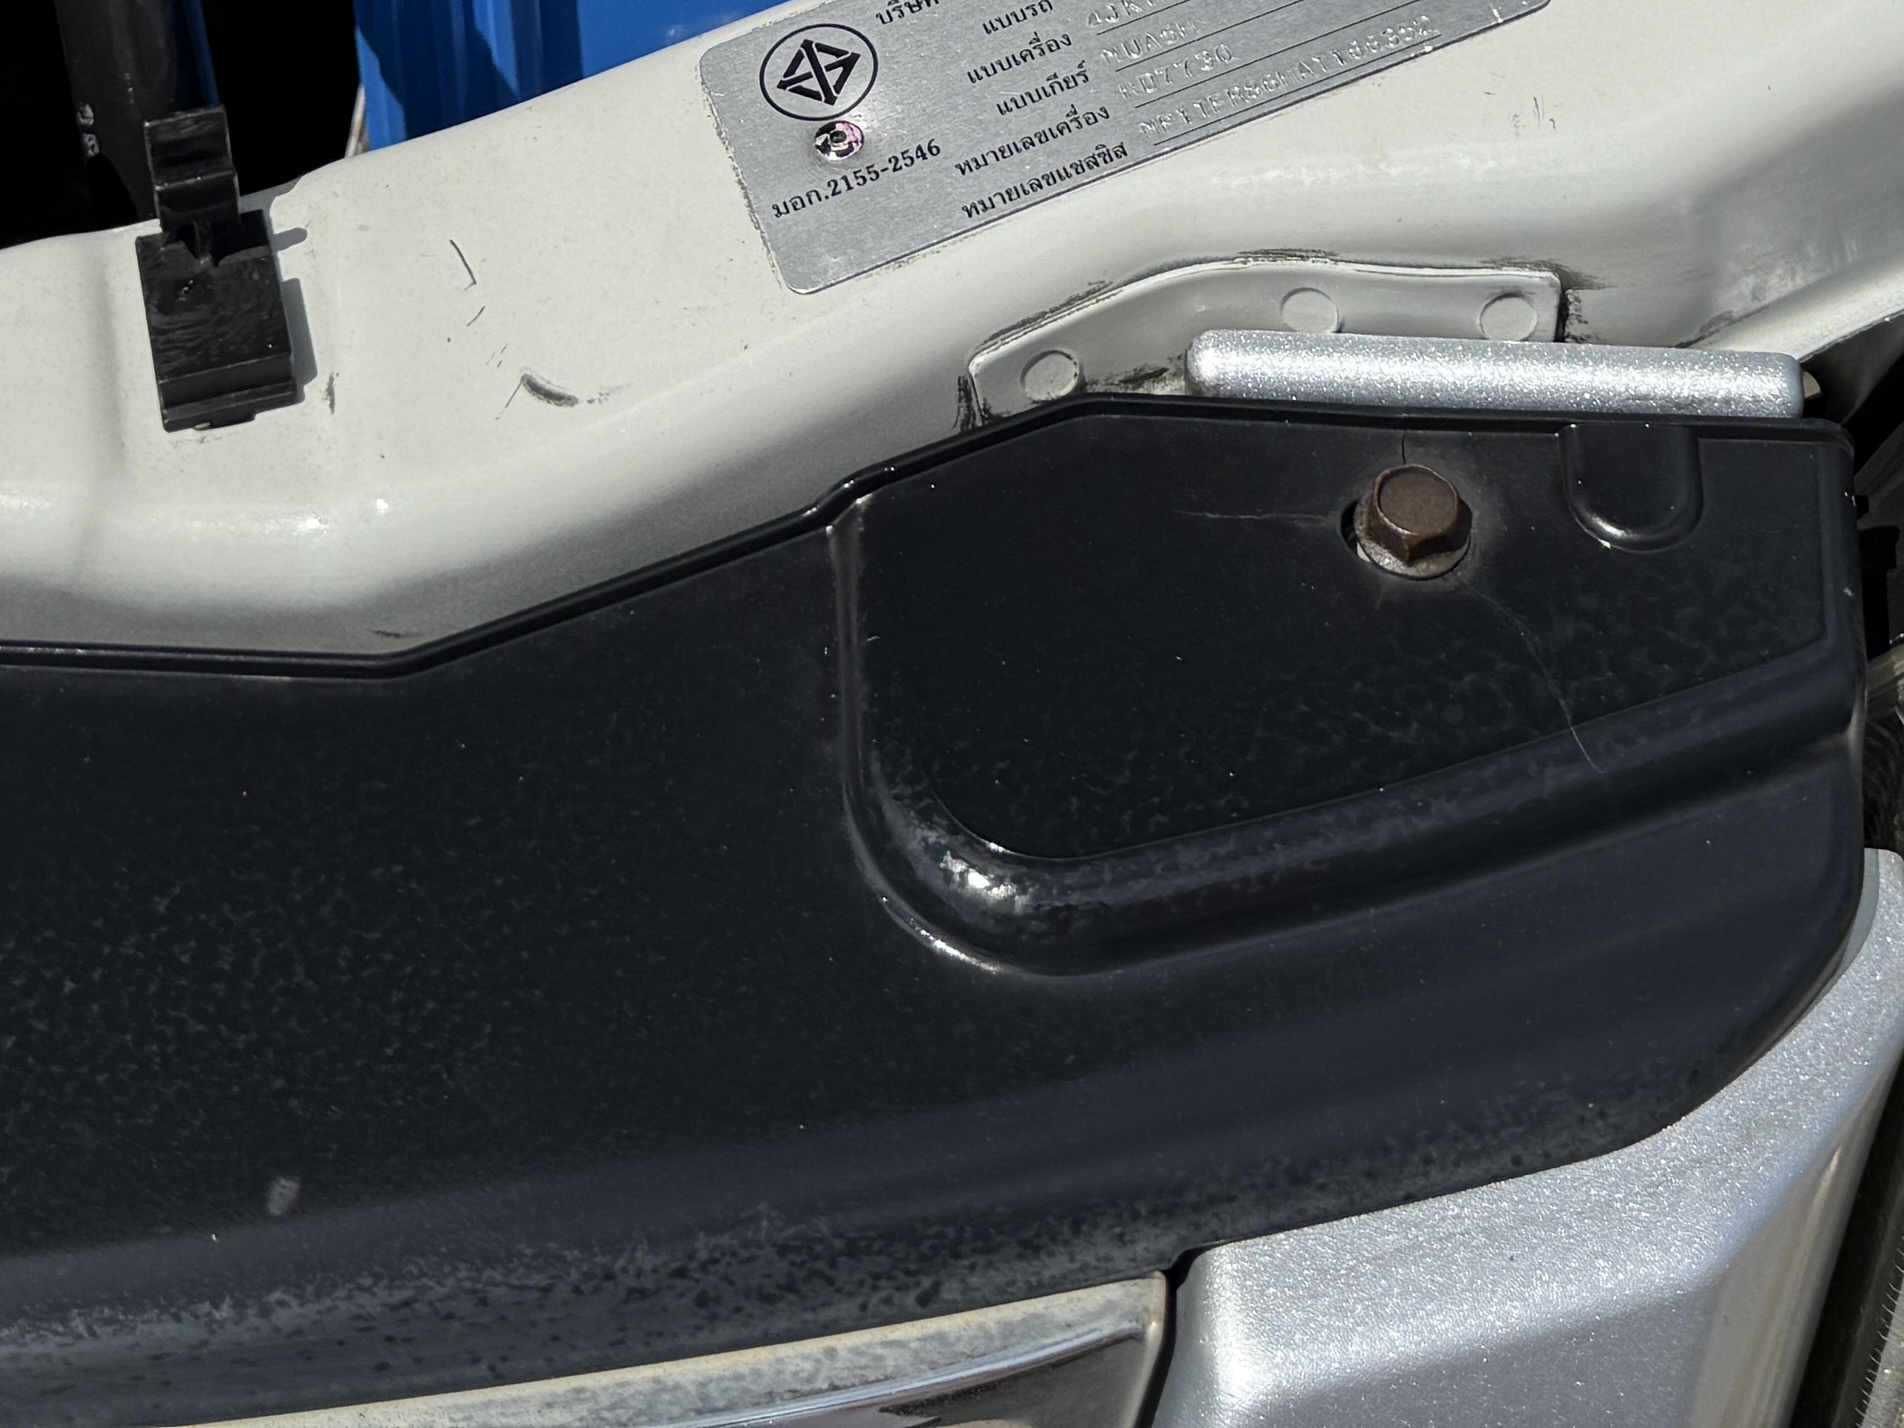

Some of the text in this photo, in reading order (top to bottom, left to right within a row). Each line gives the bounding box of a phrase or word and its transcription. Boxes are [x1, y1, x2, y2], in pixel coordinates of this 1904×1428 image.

[965, 25, 1073, 87] แบบเครื่อง
[995, 61, 1091, 119] แบบเกียร์
[771, 137, 943, 221] มอก.2155-2546
[954, 100, 1110, 180] หมายเลขเครื่อง
[962, 139, 1129, 221] หมายเลขแชสซิส
